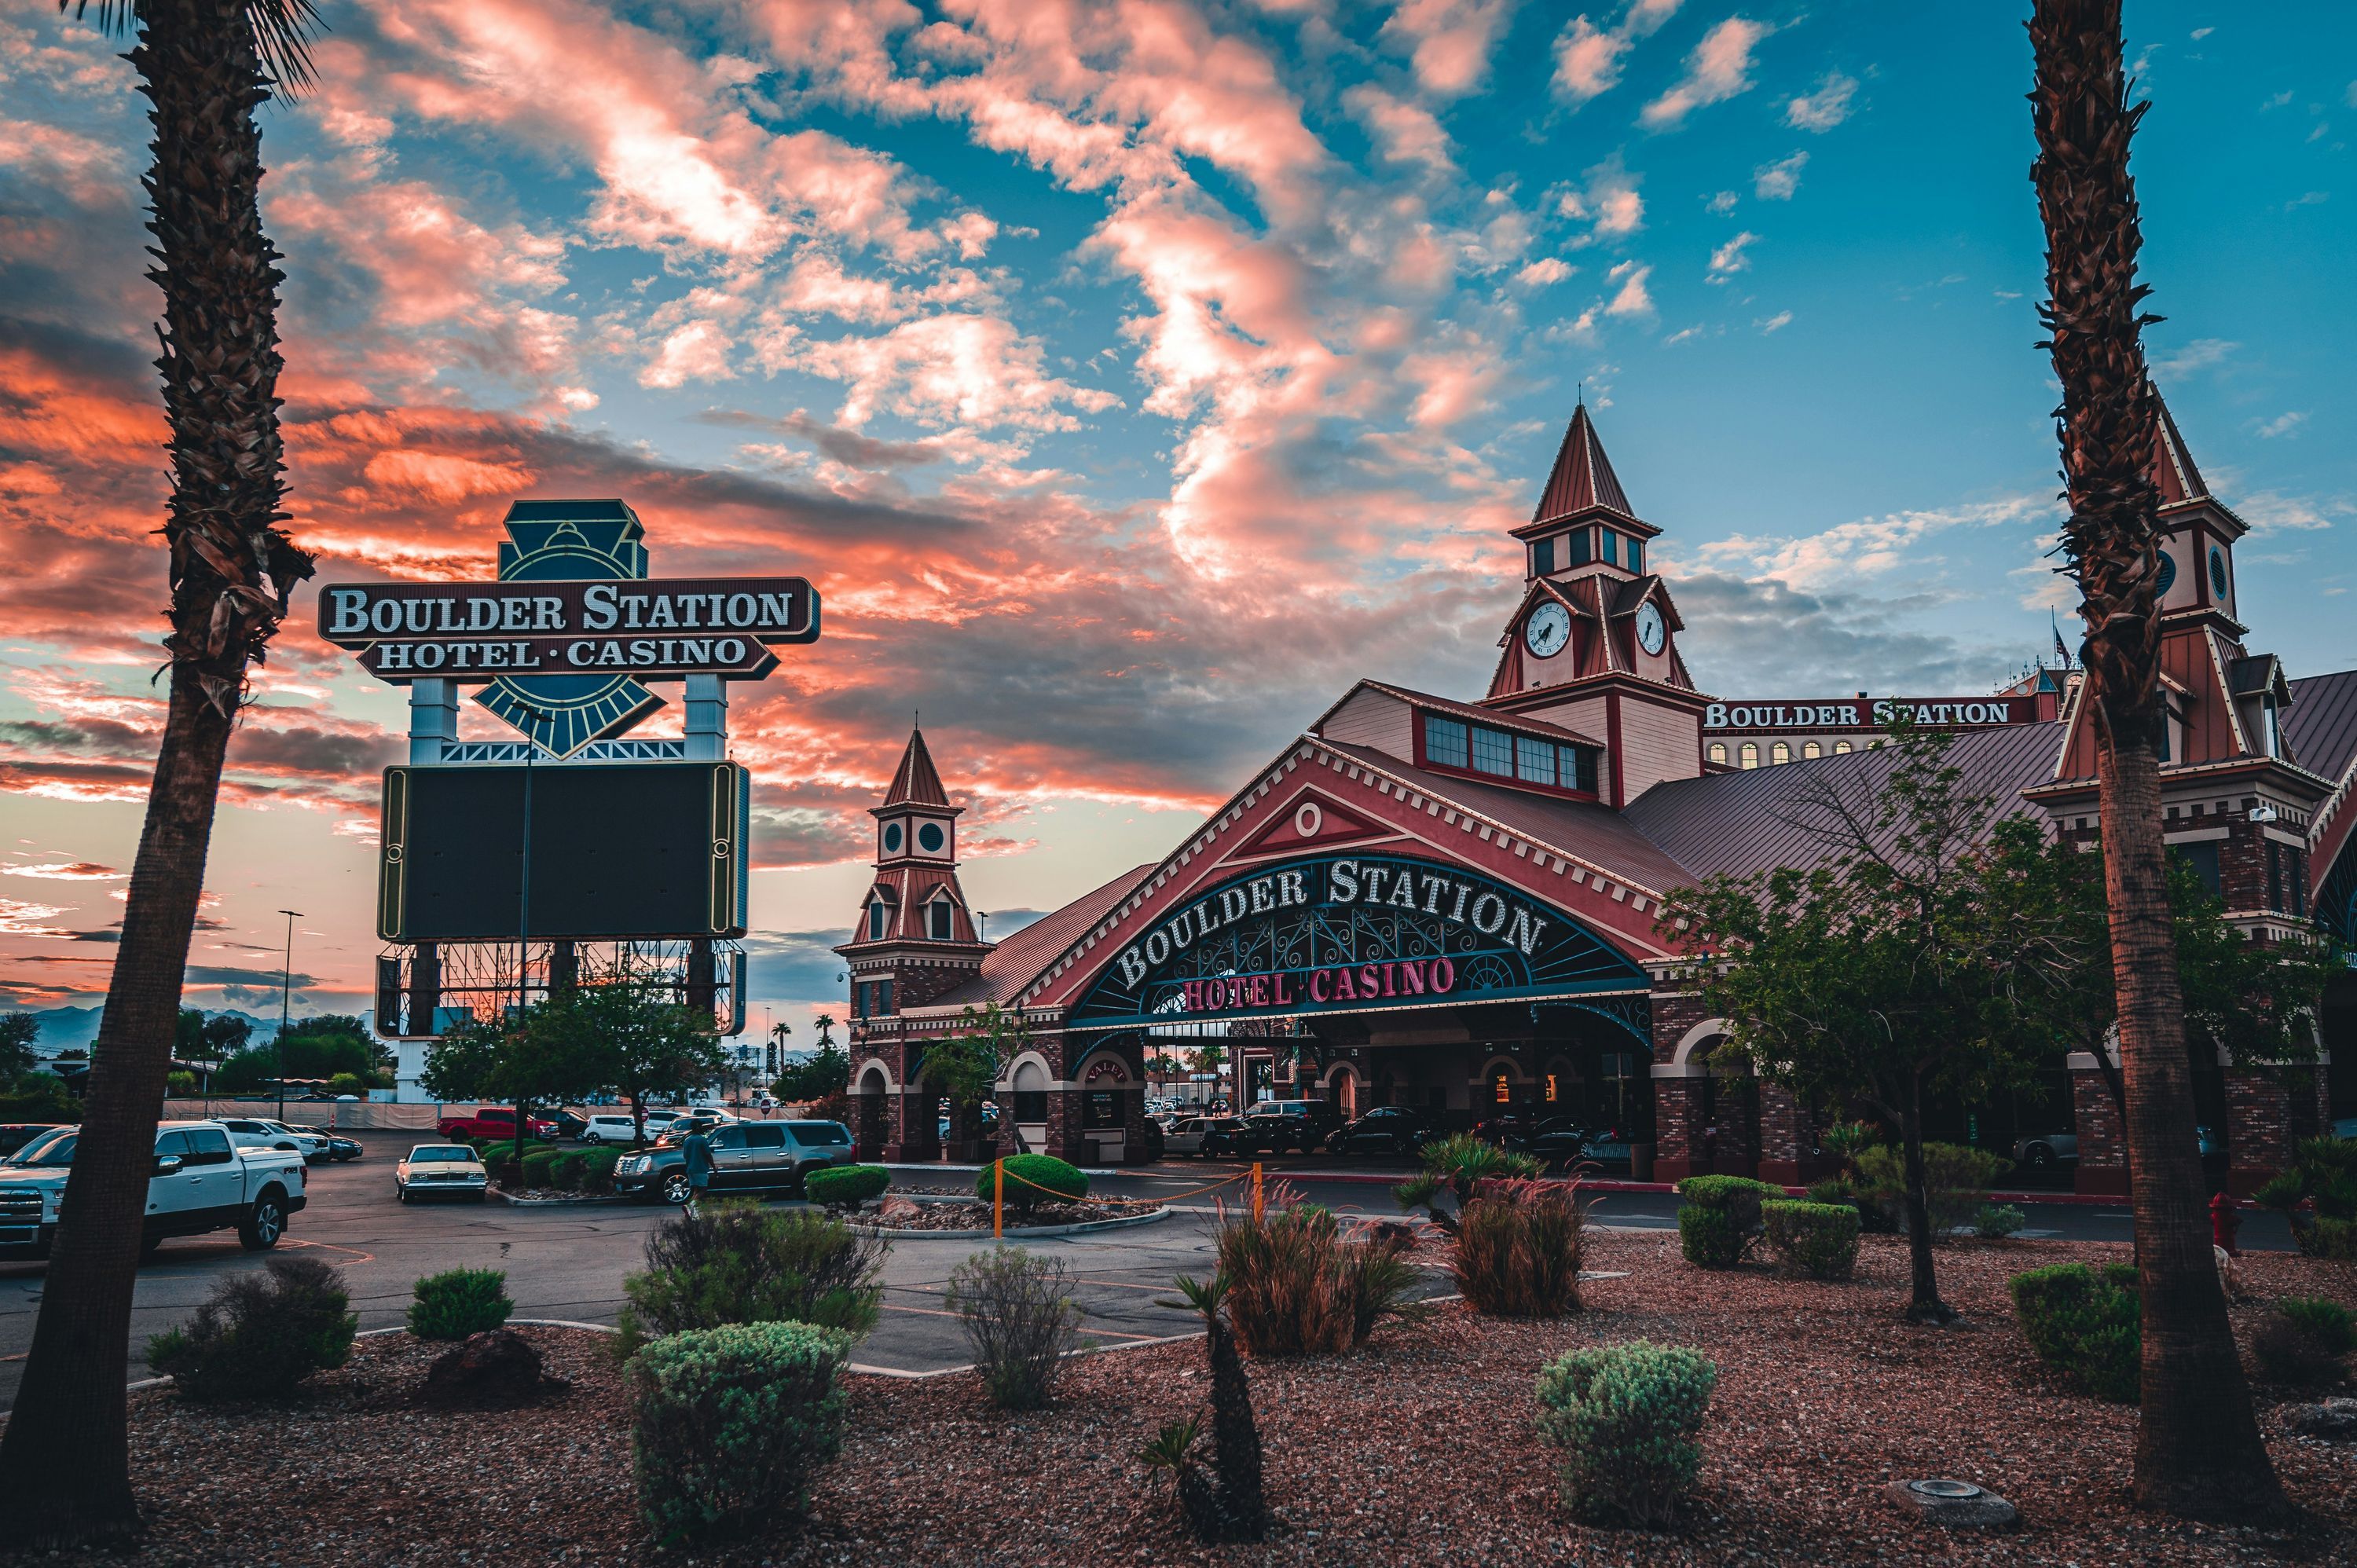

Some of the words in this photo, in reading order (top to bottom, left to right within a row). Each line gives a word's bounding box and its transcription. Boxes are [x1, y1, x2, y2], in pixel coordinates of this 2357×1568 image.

[329, 590, 566, 633] BOULDER
[583, 585, 793, 629] STATION
[377, 643, 541, 669] HOTEL
[567, 639, 746, 666] CASINO
[1703, 703, 1860, 728] BOULDER
[1872, 701, 2010, 725] STATION
[1116, 870, 1308, 991] BOULDER
[1329, 859, 1549, 956] STATION
[1182, 973, 1292, 1012] HOTEL
[1310, 957, 1455, 1003] CASINO
[1089, 1062, 1125, 1079] VALET
